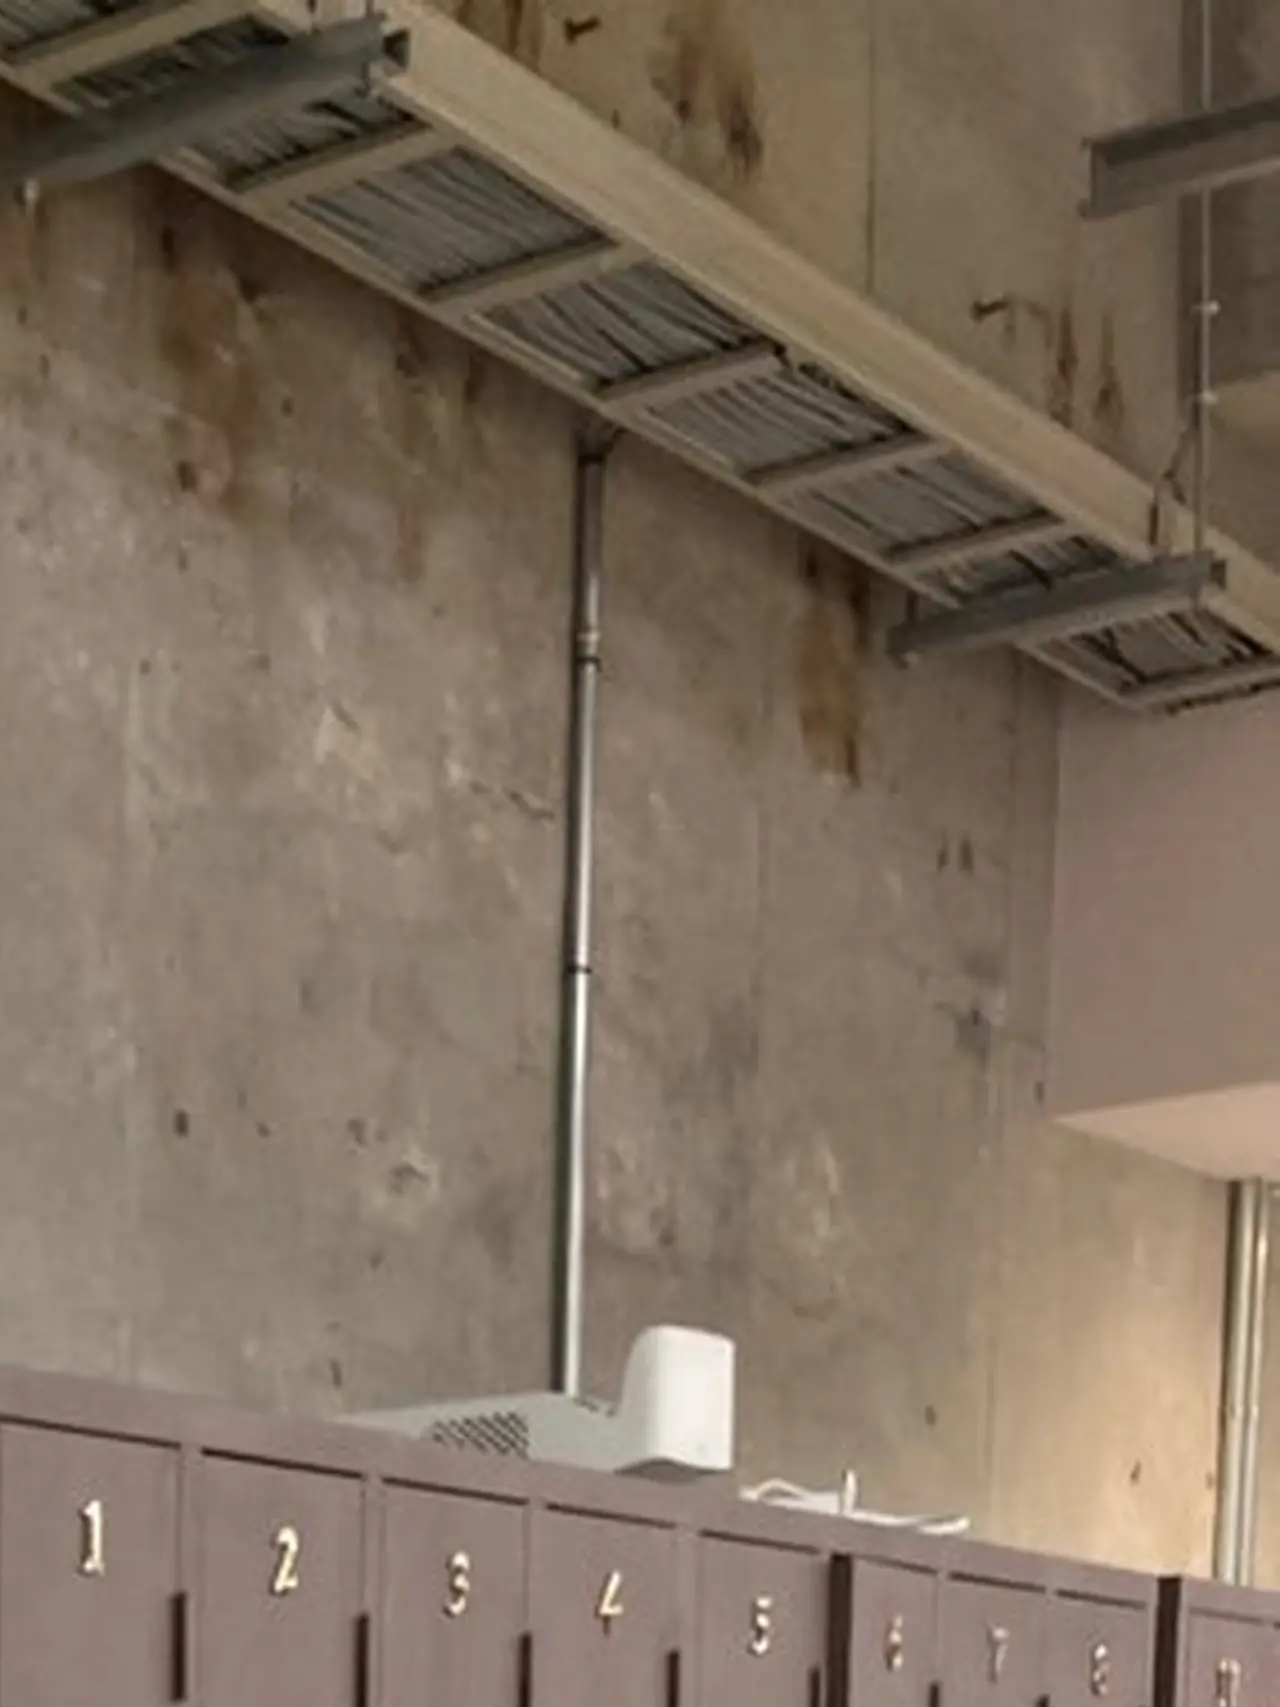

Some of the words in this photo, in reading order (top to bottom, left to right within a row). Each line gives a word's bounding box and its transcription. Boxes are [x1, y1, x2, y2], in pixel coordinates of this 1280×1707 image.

[80, 1500, 104, 1577] 1
[272, 1526, 300, 1596] 2
[444, 1552, 470, 1617] 3
[597, 1570, 624, 1635] 4
[750, 1596, 773, 1655] 5
